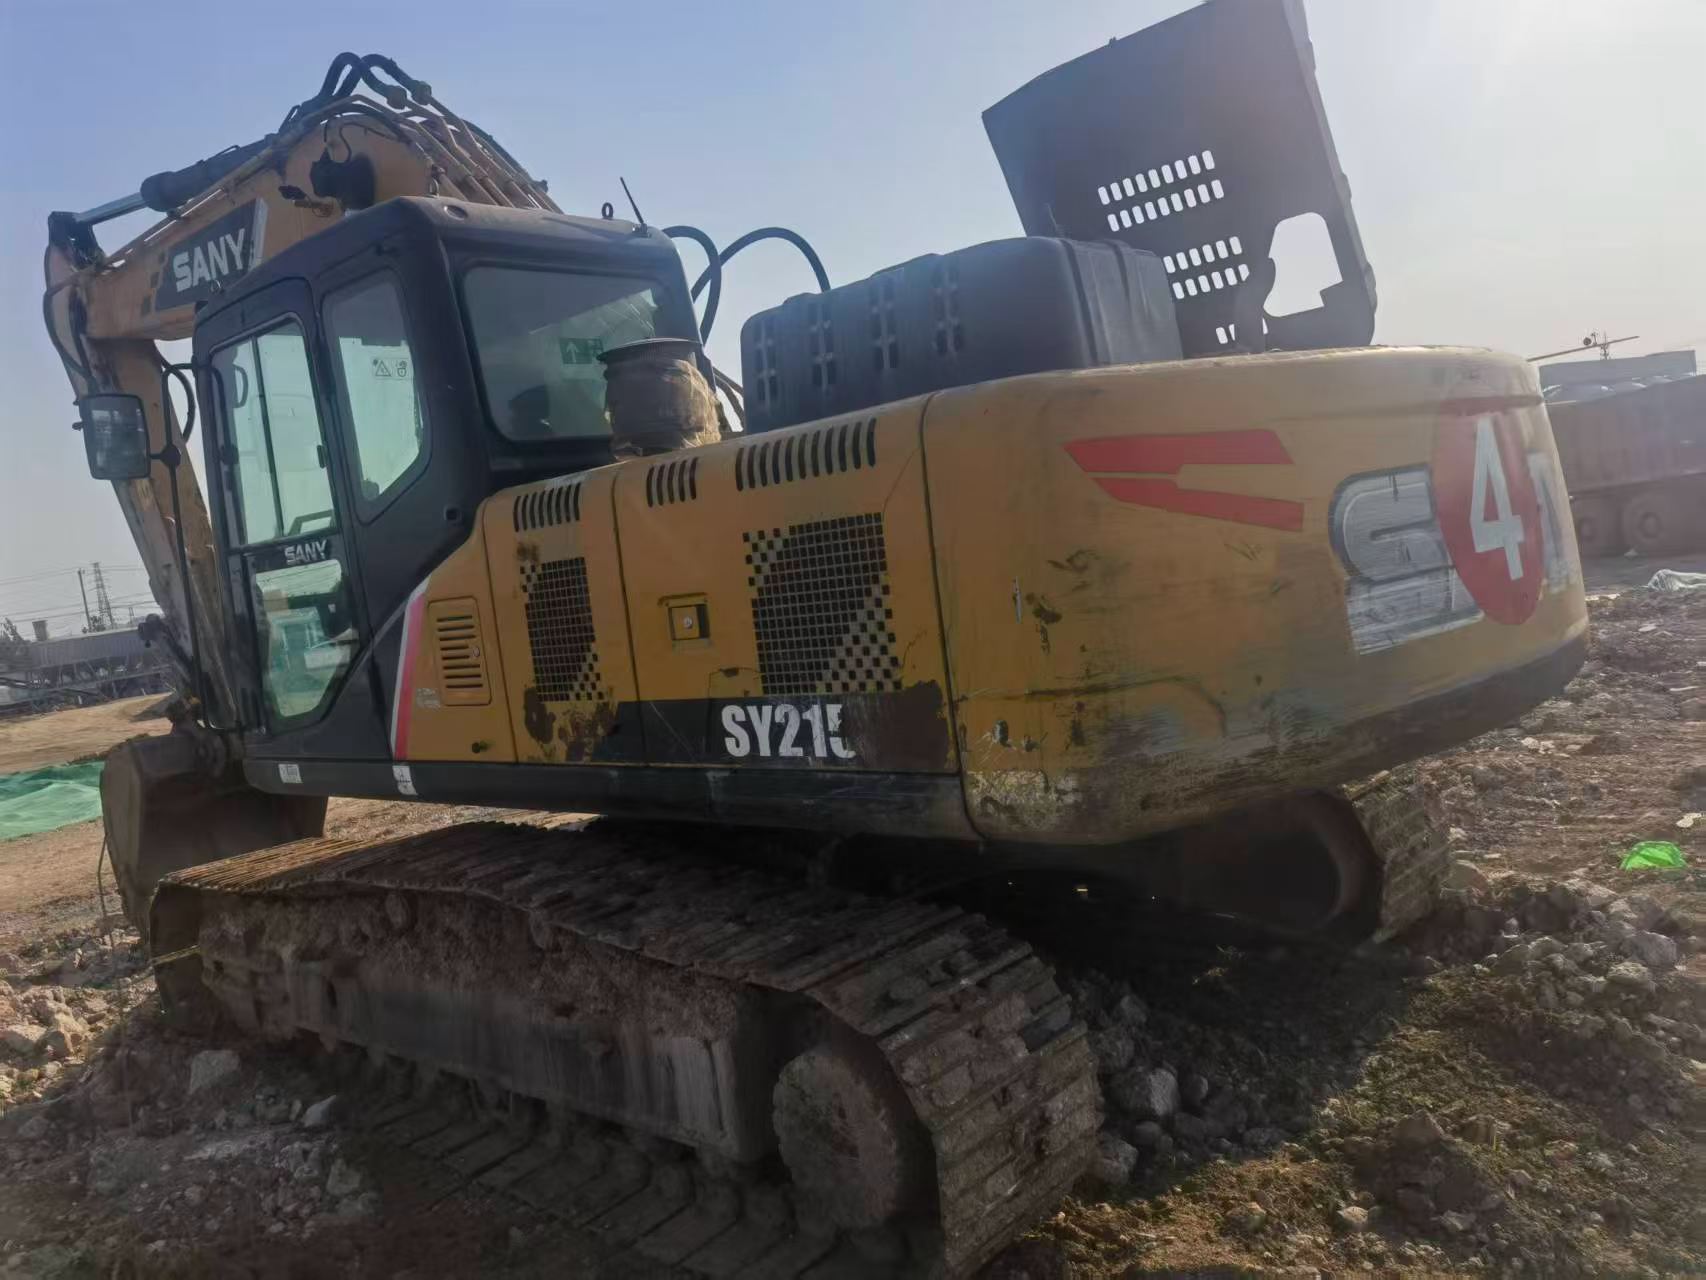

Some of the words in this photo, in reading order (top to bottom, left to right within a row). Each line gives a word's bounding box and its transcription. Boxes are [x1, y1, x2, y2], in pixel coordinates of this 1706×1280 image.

[173, 228, 245, 293] SANY
[1470, 416, 1524, 581] 4
[284, 539, 328, 566] SANY
